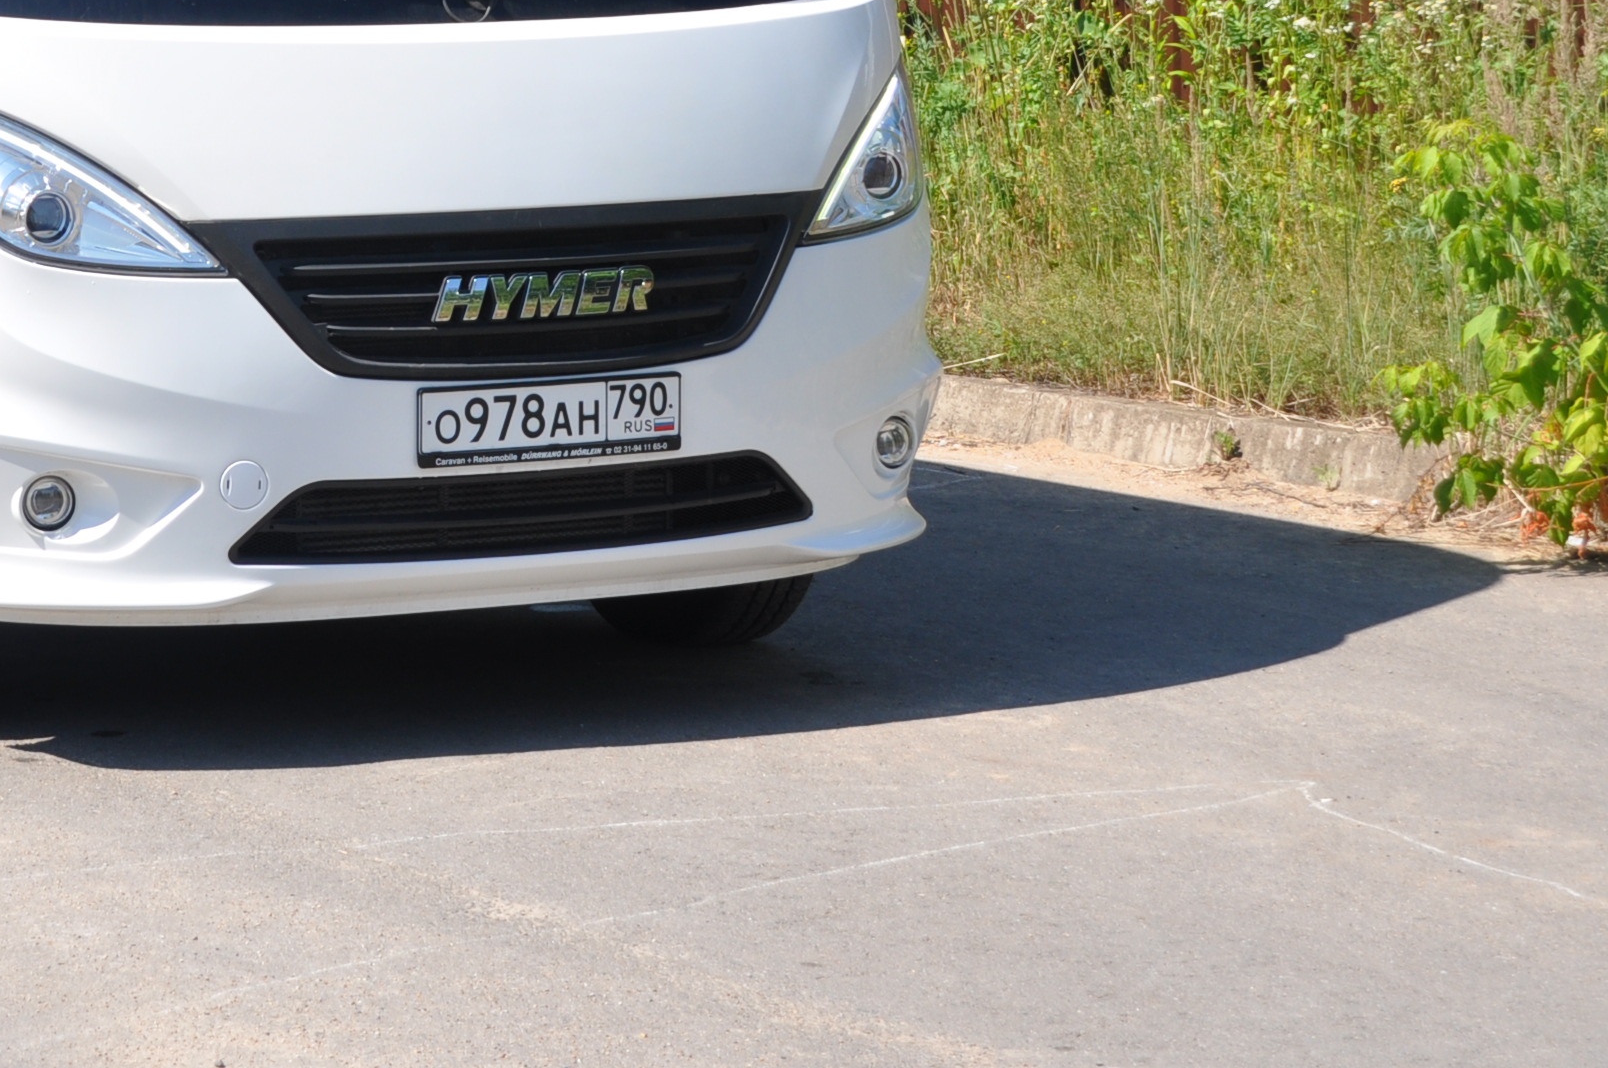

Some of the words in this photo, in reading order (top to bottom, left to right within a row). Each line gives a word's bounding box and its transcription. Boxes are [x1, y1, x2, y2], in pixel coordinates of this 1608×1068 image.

[431, 265, 654, 322] HYMER
[435, 393, 600, 444] O978AH
[609, 381, 668, 420] 790
[624, 419, 653, 433] RUS
[435, 457, 466, 466] Caravan
[473, 453, 518, 464] Reisemobile
